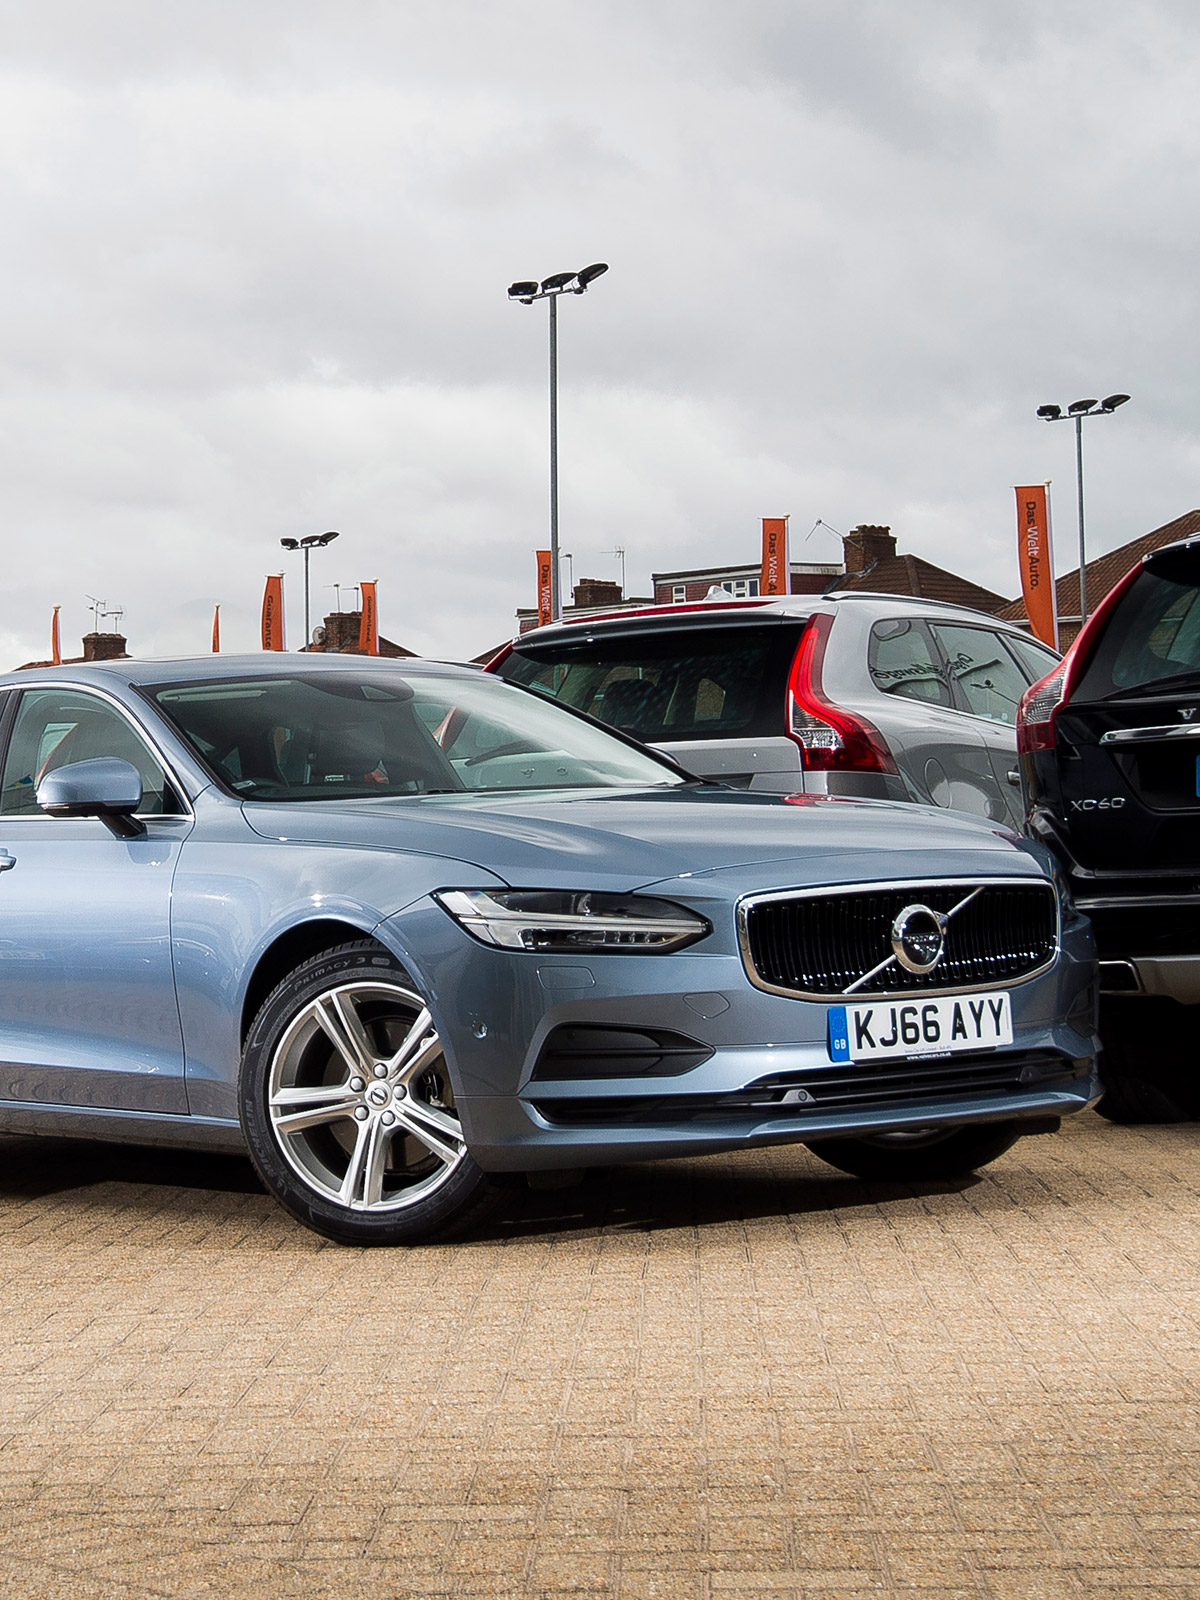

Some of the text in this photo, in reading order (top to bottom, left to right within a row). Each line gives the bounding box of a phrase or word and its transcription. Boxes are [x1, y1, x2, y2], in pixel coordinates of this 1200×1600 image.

[1026, 501, 1037, 525] Das
[541, 564, 550, 585] Das
[768, 532, 778, 595] Das WeltA
[264, 594, 274, 651] Guarante
[853, 1003, 941, 1050] KJ66
[951, 998, 1004, 1041] AYY
[834, 1038, 847, 1050] GB
